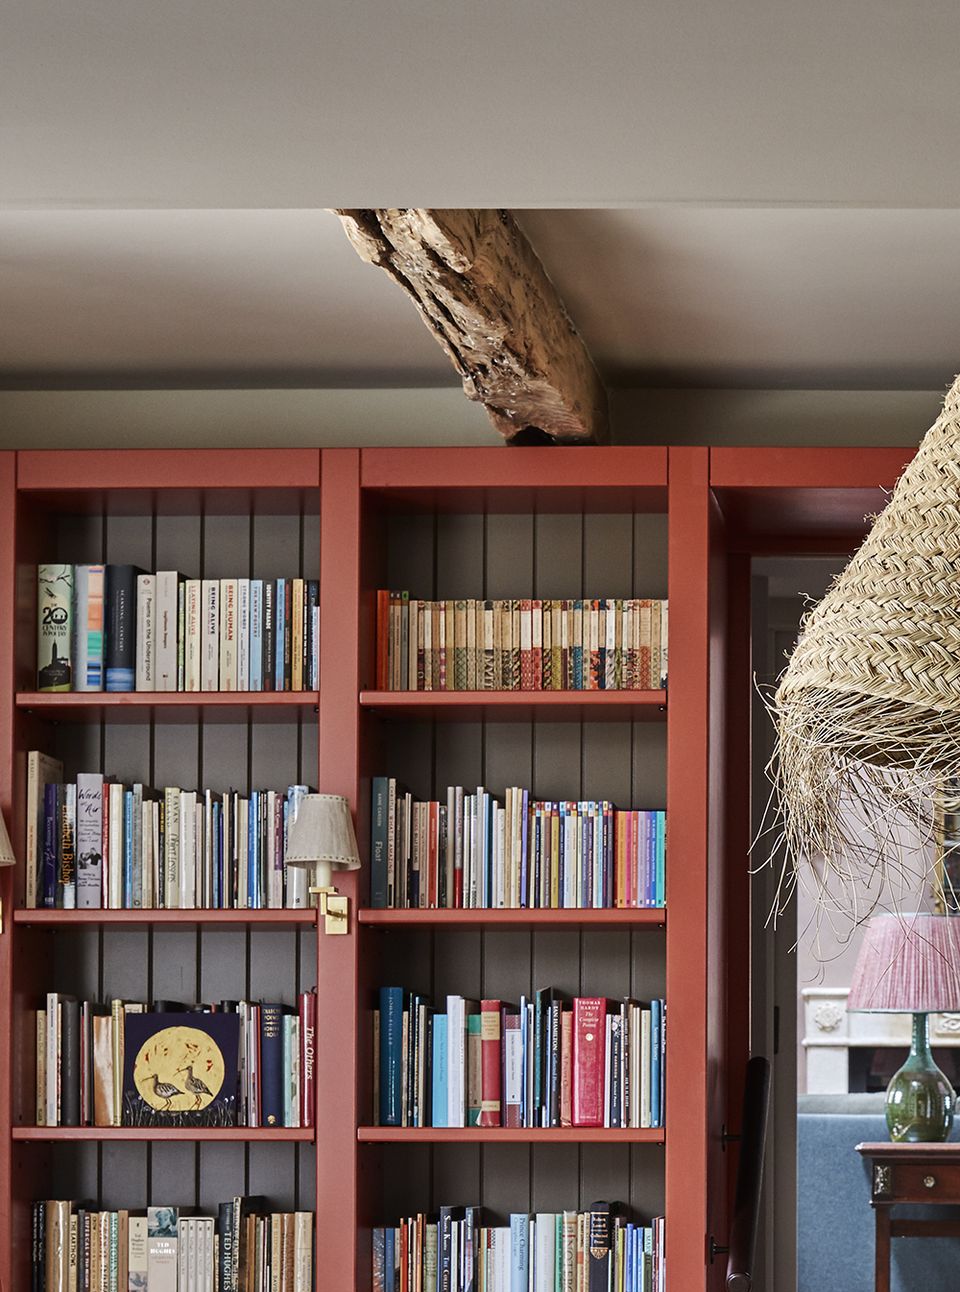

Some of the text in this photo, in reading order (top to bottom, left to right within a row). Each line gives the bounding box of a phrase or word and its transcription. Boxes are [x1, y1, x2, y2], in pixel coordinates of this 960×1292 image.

[79, 789, 101, 800] Words
[59, 853, 74, 886] Bishop
[306, 1026, 314, 1080] The Others
[223, 1231, 232, 1291] TED HUGHES
[518, 1239, 526, 1271] Charming
